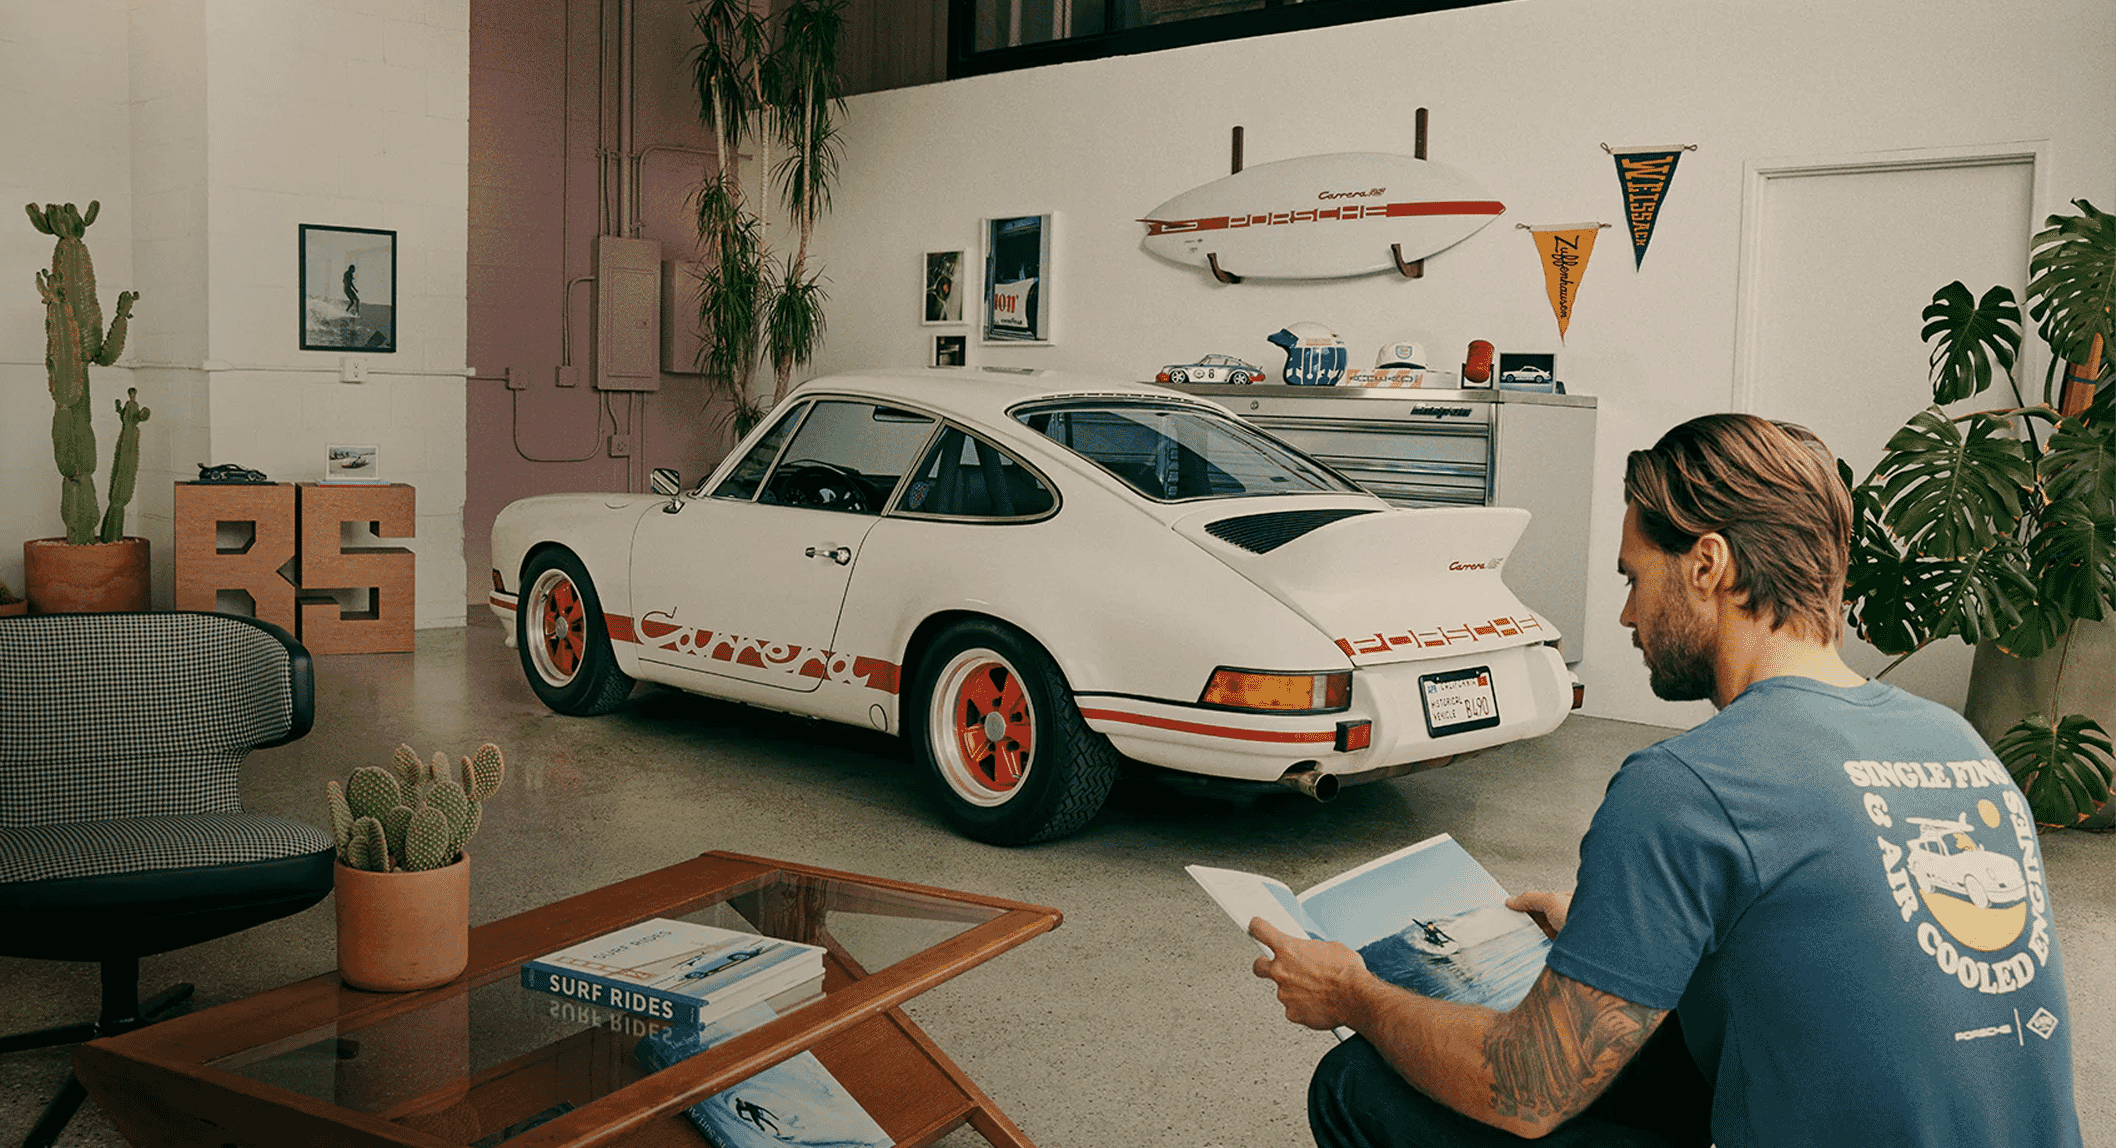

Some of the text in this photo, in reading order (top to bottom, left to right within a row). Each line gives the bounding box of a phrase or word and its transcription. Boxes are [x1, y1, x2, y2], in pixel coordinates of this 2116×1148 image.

[1228, 204, 1387, 229] PORSCHE
[1318, 190, 1367, 201] Carrera
[1620, 155, 1675, 247] WEISSACH
[1551, 235, 1580, 319] Zuffenhausen
[1448, 560, 1485, 571] Carrera
[635, 605, 872, 687] Carrera
[1350, 614, 1543, 655] PORSCHE
[1843, 759, 2009, 788] SINGLE FINS
[1877, 836, 1919, 922] AIR
[1917, 921, 2035, 994] COOLED
[550, 973, 603, 1002] SURF
[610, 987, 674, 1020] RIDES
